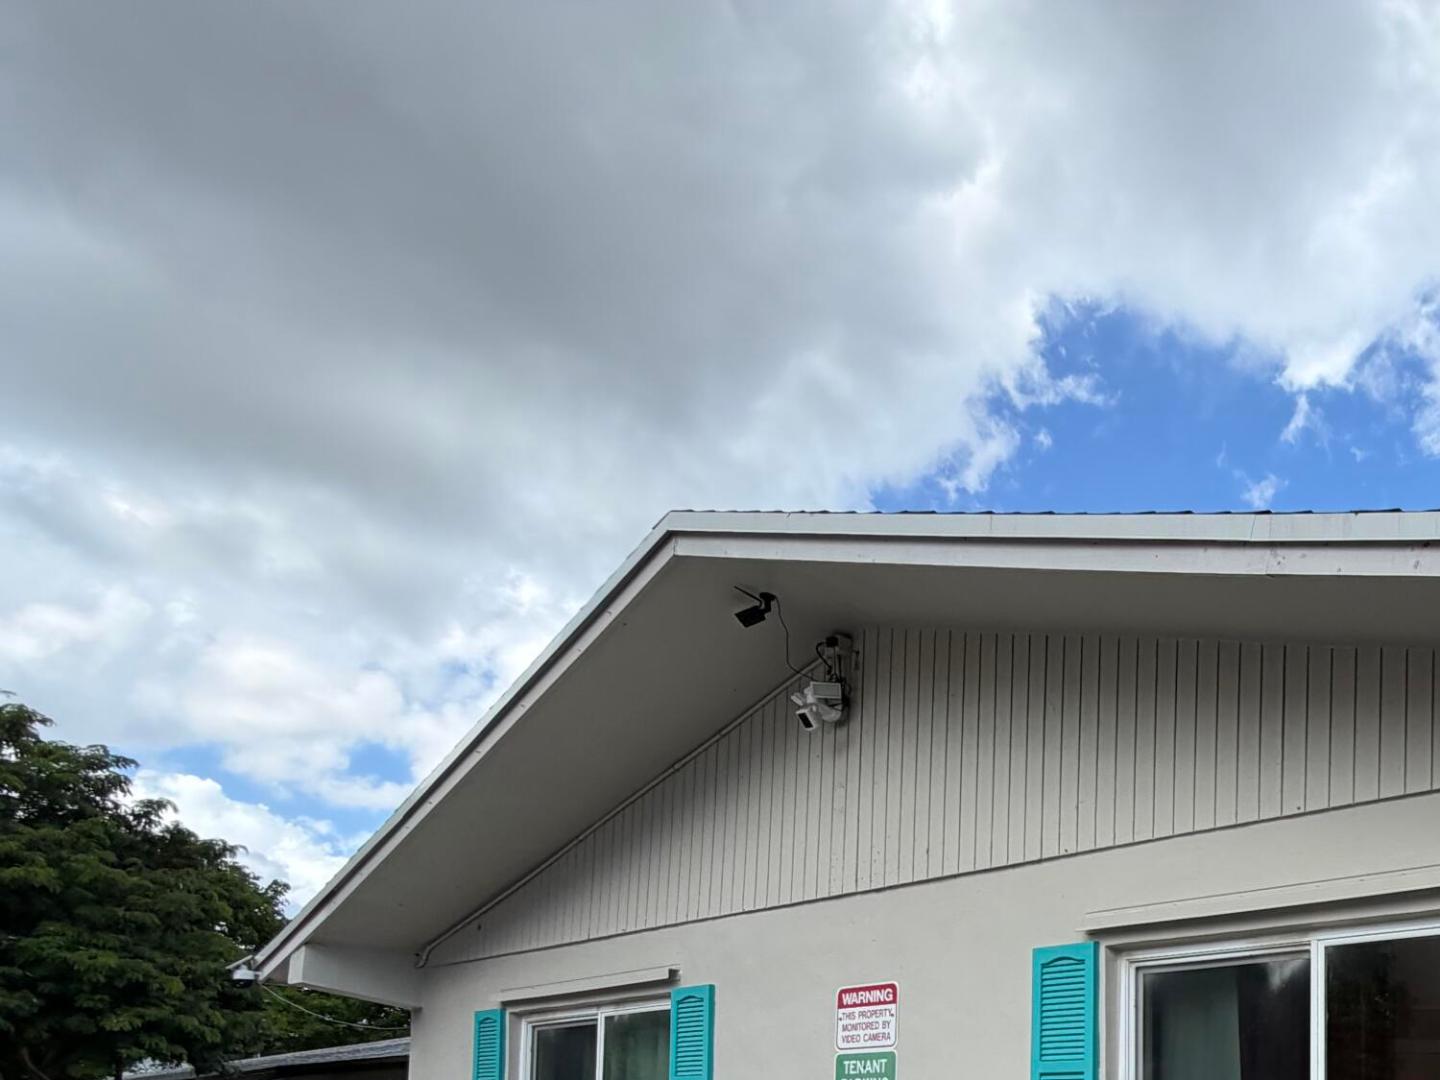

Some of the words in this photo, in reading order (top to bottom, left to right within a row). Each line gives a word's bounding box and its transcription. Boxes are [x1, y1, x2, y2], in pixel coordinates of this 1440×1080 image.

[842, 988, 893, 1006] WARNING
[842, 1012, 856, 1021] THIS
[858, 1008, 892, 1019] PROPERTY
[842, 1021, 880, 1032] MONITORED
[882, 1020, 891, 1029] BY
[842, 1034, 861, 1044] VIDEO
[863, 1032, 891, 1042] CAMERA
[843, 1059, 888, 1075] TENANT
